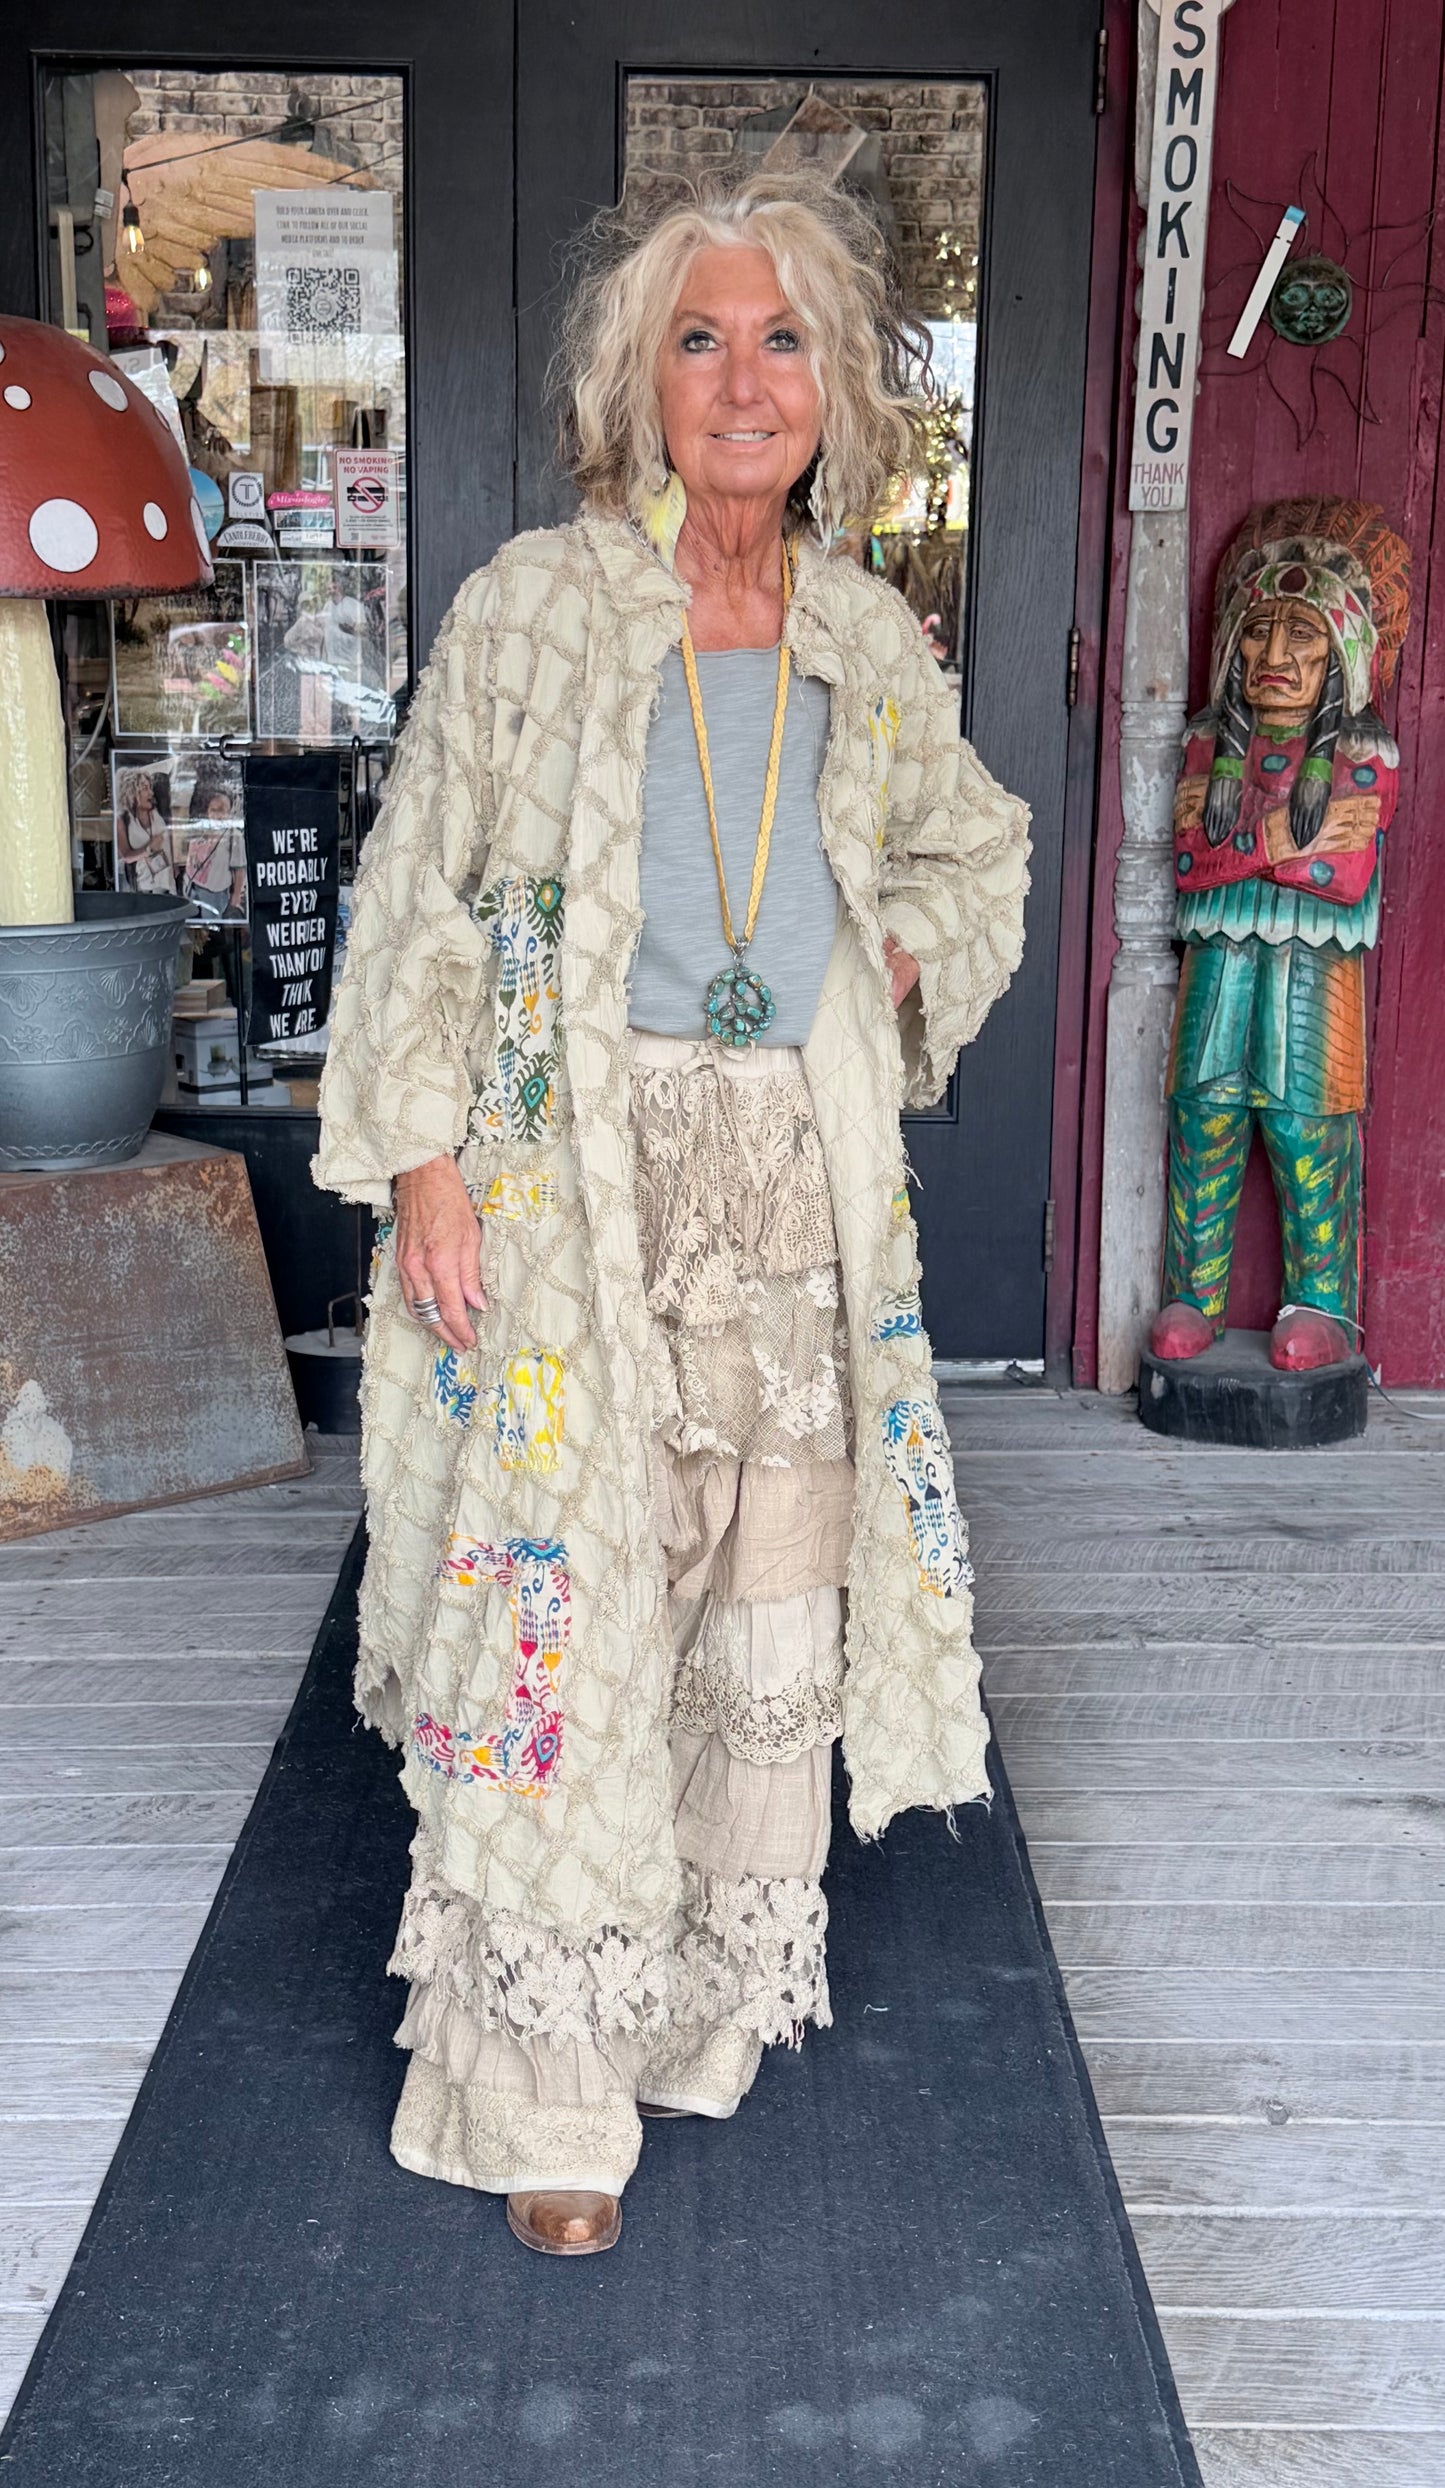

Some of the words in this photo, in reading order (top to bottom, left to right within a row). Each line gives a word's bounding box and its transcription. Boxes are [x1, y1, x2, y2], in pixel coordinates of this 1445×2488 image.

[305, 206, 325, 216] CAMERA
[326, 207, 339, 216] OVER
[341, 207, 352, 216] AND
[329, 235, 340, 244] AND
[1146, 1, 1206, 453] SMOKING
[343, 466, 356, 474] NO
[358, 466, 389, 474] VAPING
[1132, 462, 1184, 485] THANK
[1141, 486, 1173, 508] YOU
[272, 828, 318, 855] WE'RE
[256, 857, 328, 888] PROBABLY
[280, 889, 318, 916] EVEN
[266, 917, 326, 947] WEIRDER
[269, 951, 305, 979] THAN
[270, 1012, 290, 1039] WE
[294, 1008, 317, 1035] ARE.
